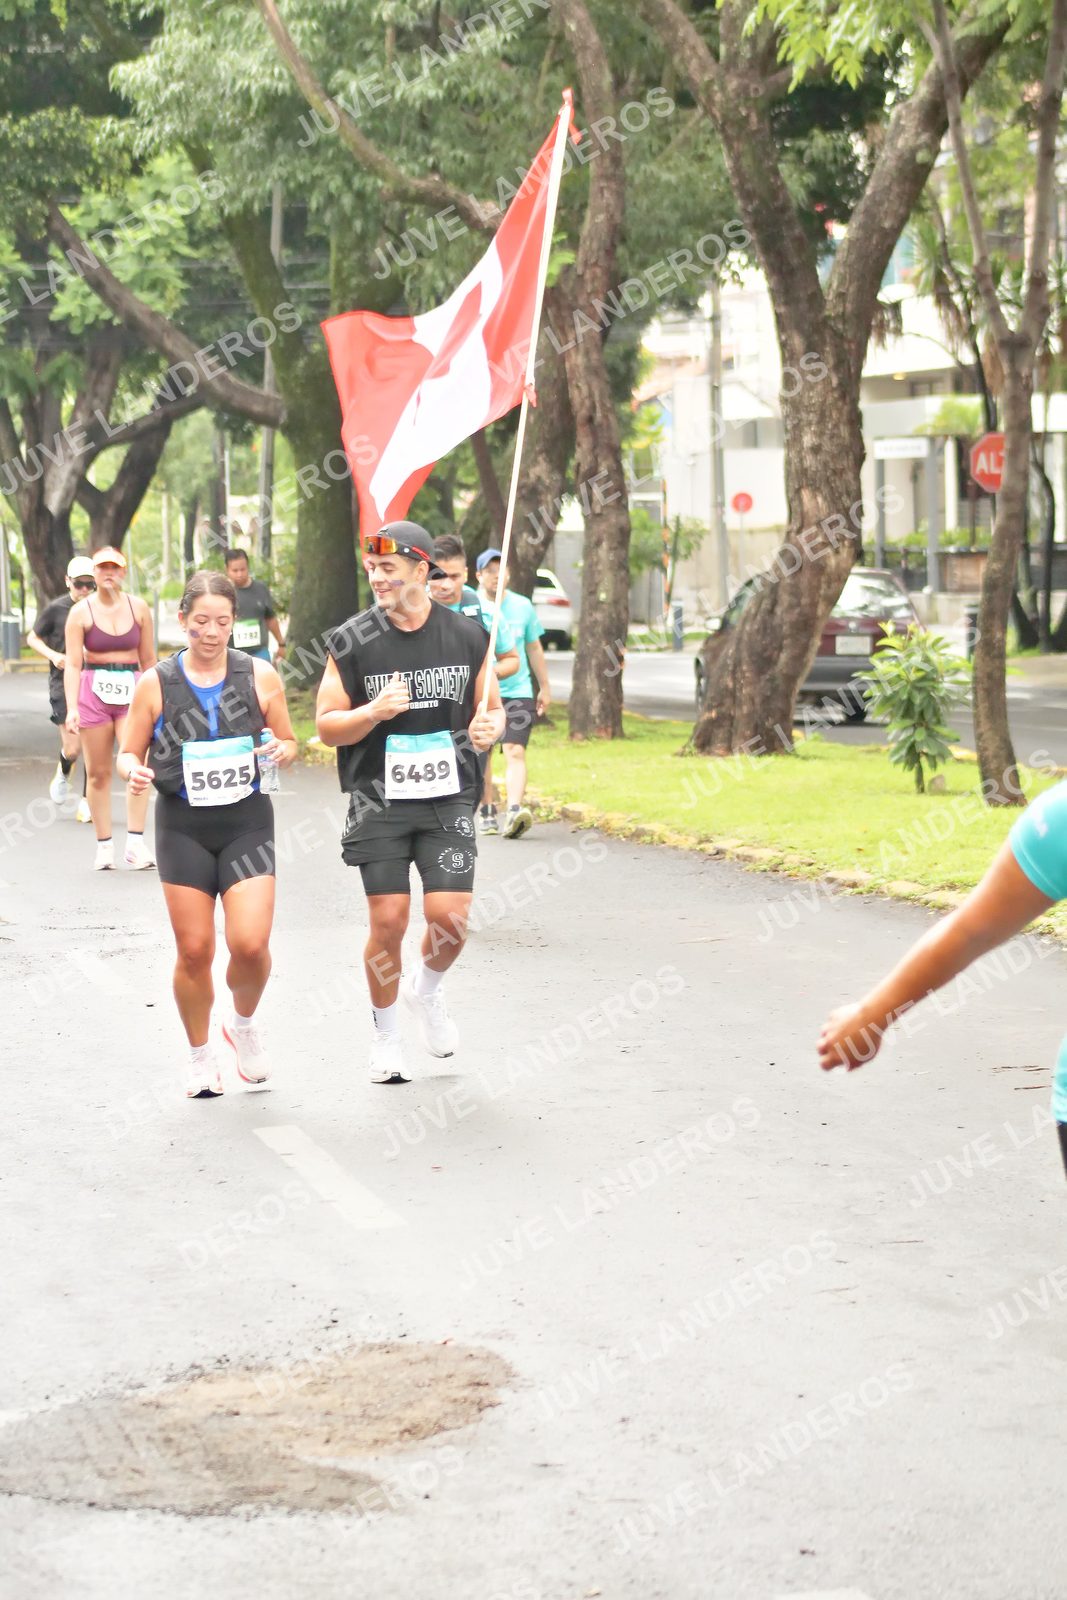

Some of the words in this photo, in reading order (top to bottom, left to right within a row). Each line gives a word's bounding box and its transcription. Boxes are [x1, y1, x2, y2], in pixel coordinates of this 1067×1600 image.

[96, 682, 129, 696] 3951
[364, 671, 413, 701] SWT
[414, 665, 470, 704] SOCIETY
[409, 700, 439, 709] ORONTO
[191, 765, 251, 791] 5625
[391, 760, 451, 783] 6489
